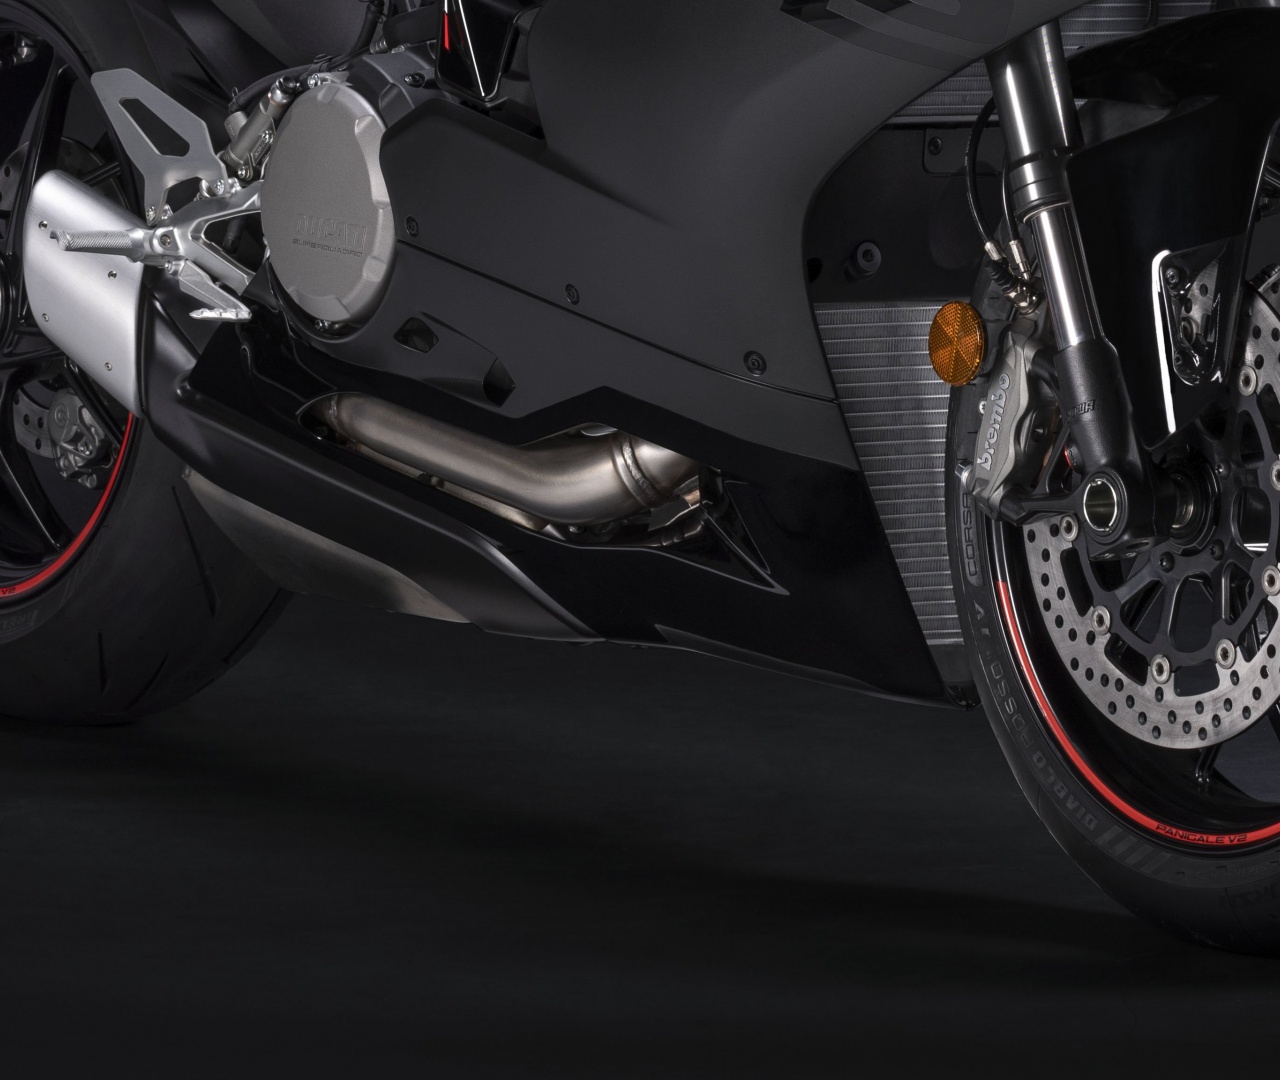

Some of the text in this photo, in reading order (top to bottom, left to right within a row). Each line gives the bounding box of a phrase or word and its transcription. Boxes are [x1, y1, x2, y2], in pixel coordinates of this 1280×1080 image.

[976, 373, 1011, 471] brembo
[962, 492, 978, 577] CORSA
[1, 586, 16, 595] V2
[990, 660, 1035, 750] ROSSO
[1032, 750, 1099, 832] DIABLO
[1156, 823, 1248, 844] PANIGALE V2
